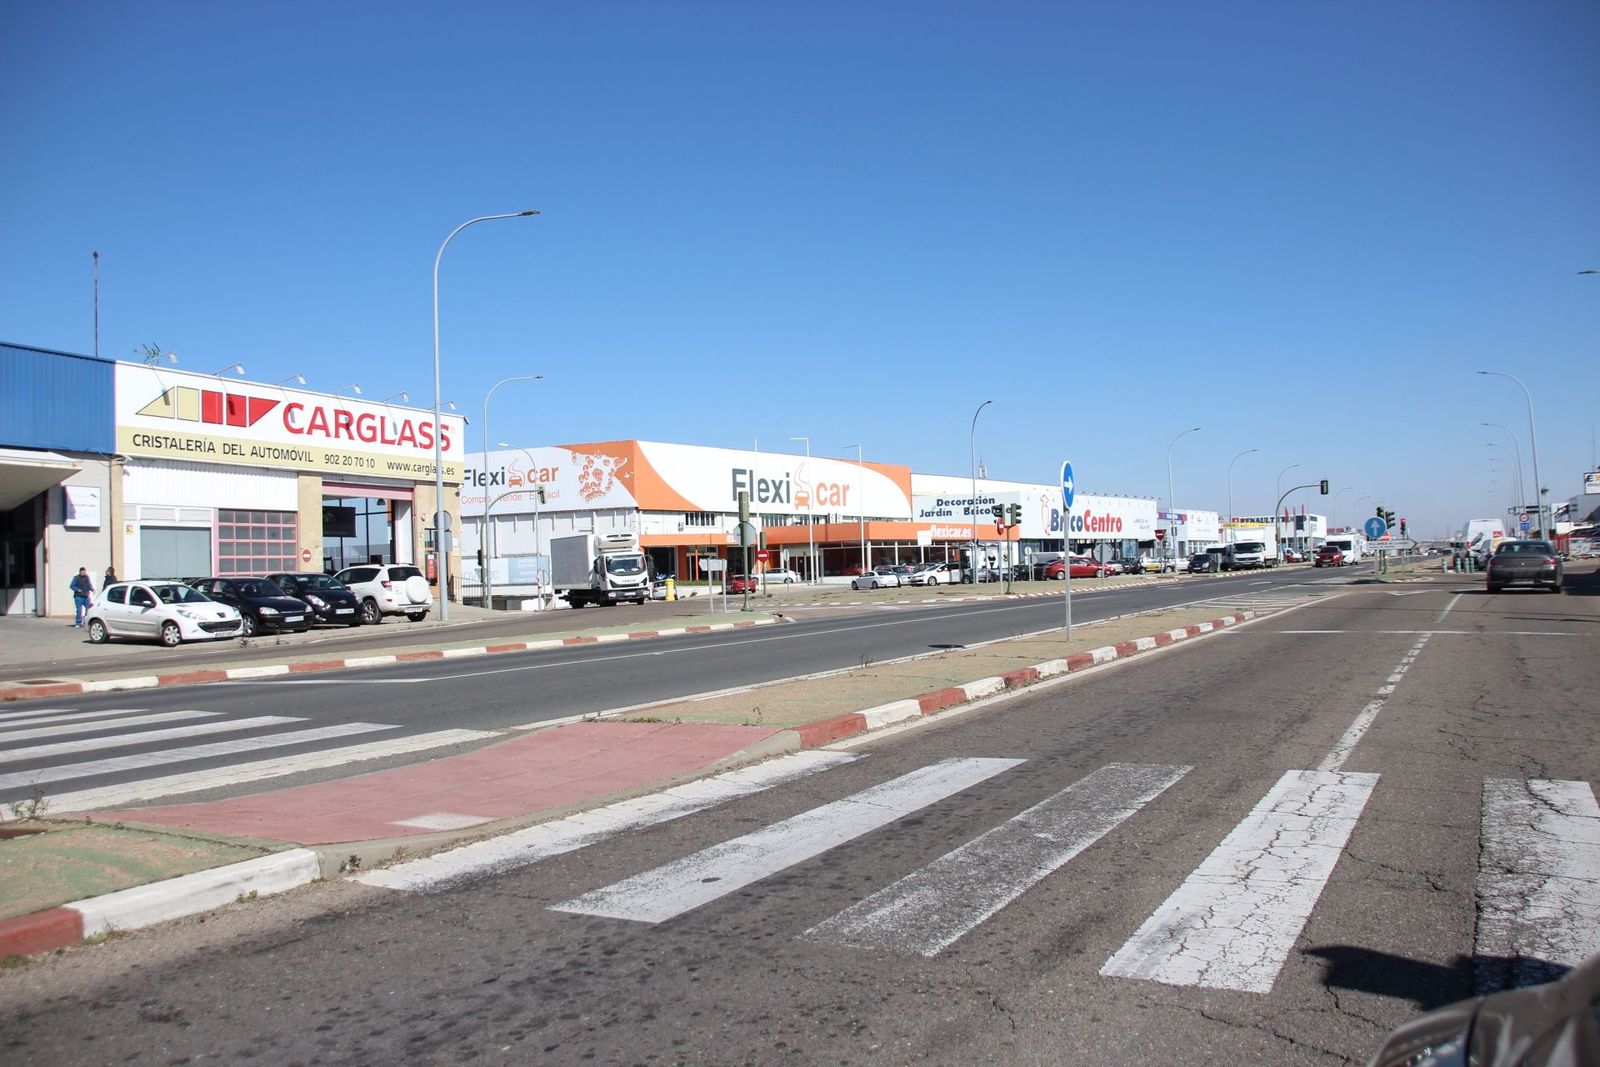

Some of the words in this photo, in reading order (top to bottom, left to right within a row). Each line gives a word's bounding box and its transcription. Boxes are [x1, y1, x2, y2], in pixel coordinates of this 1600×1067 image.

[282, 402, 451, 451] CARGLASS
[132, 433, 216, 453] CRISTALERÍA
[223, 442, 245, 456] DEL
[250, 446, 314, 463] AUTOMÓVIL
[324, 454, 339, 464] 902
[342, 455, 353, 466] 20
[354, 457, 364, 467] 70
[366, 458, 375, 468] 10
[387, 461, 455, 476] www.carglas.es
[527, 466, 559, 484] car
[732, 468, 791, 503] Flexi
[816, 482, 850, 506] car
[461, 495, 491, 504] Compa
[964, 504, 1012, 516] Bricole
[1050, 509, 1122, 532] BrcoCentro
